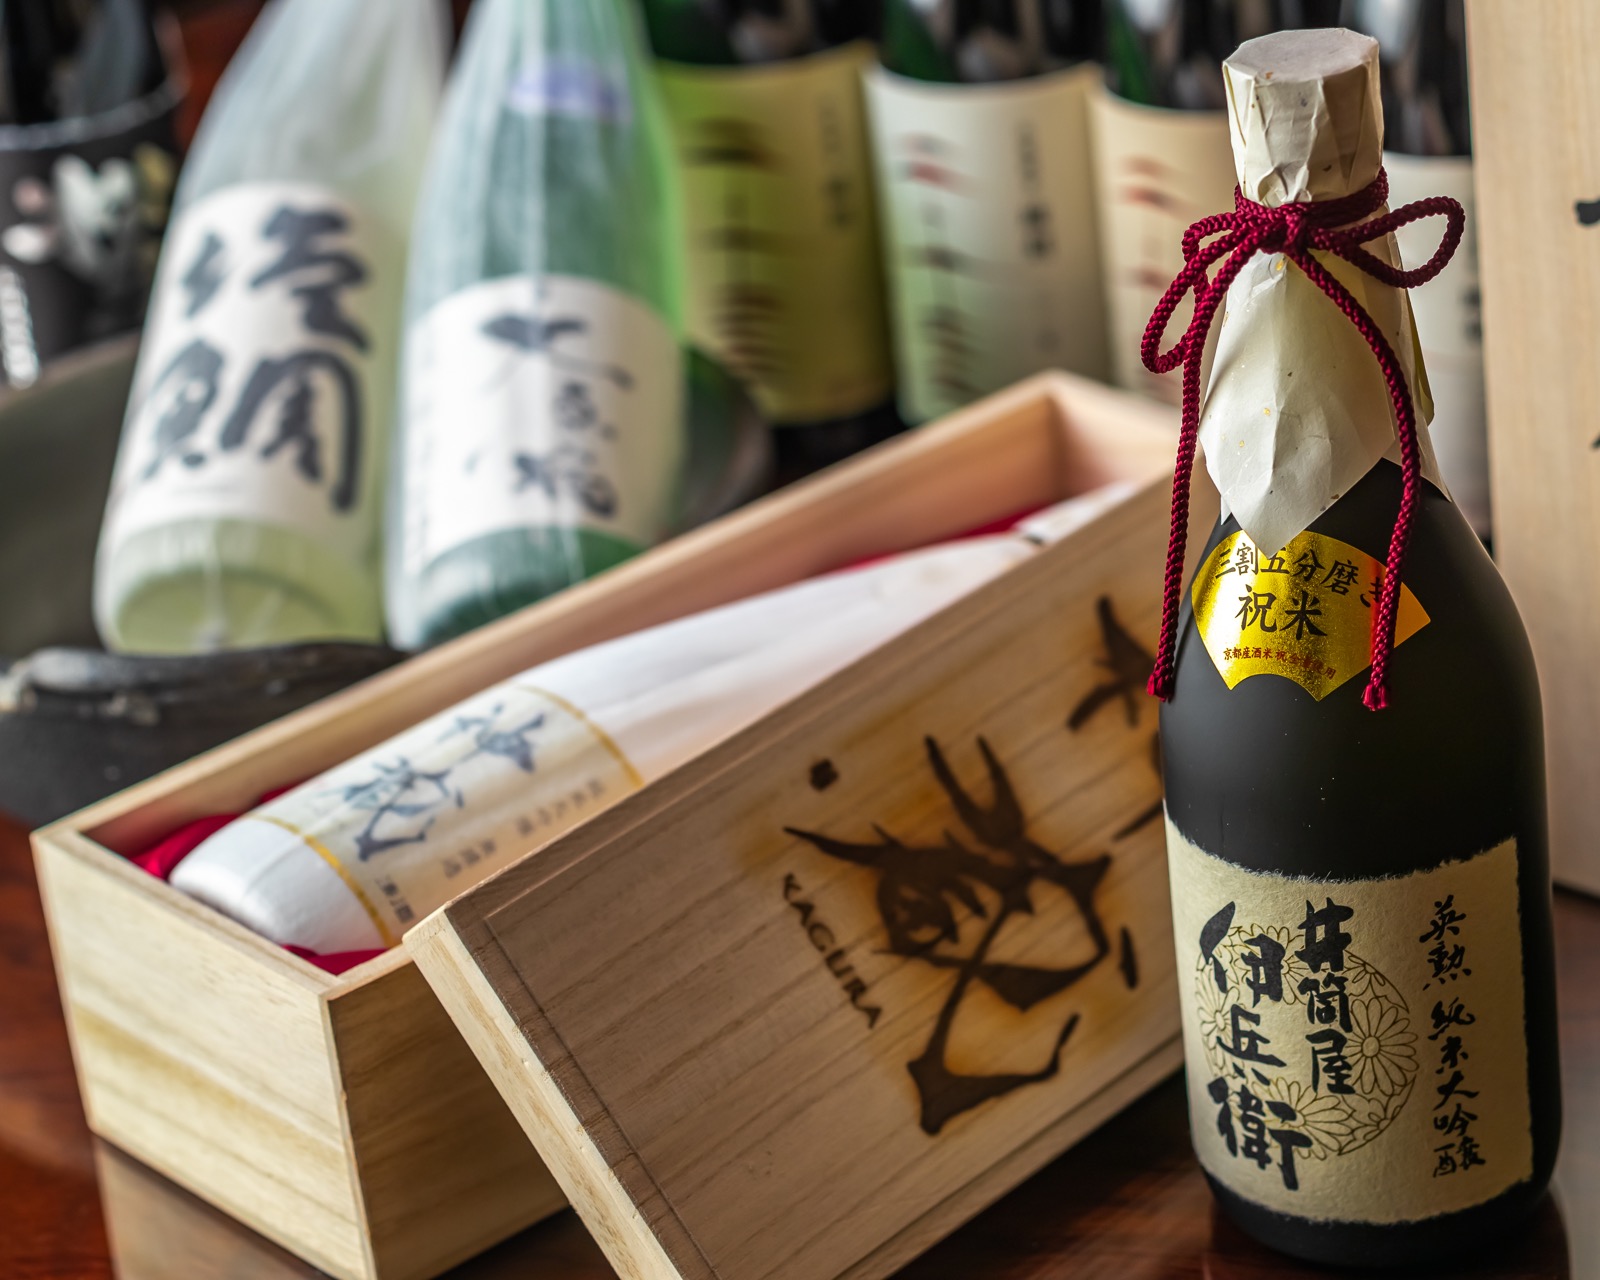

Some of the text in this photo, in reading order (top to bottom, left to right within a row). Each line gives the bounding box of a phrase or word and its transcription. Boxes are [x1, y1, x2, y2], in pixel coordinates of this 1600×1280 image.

[1235, 584, 1328, 640] 祝米
[782, 873, 881, 1030] KAGURA
[1199, 901, 1313, 1191] 伊兵衛
[1295, 897, 1356, 1095] 井筒屋
[1419, 894, 1486, 1178] 英勲 純米大吟醸
